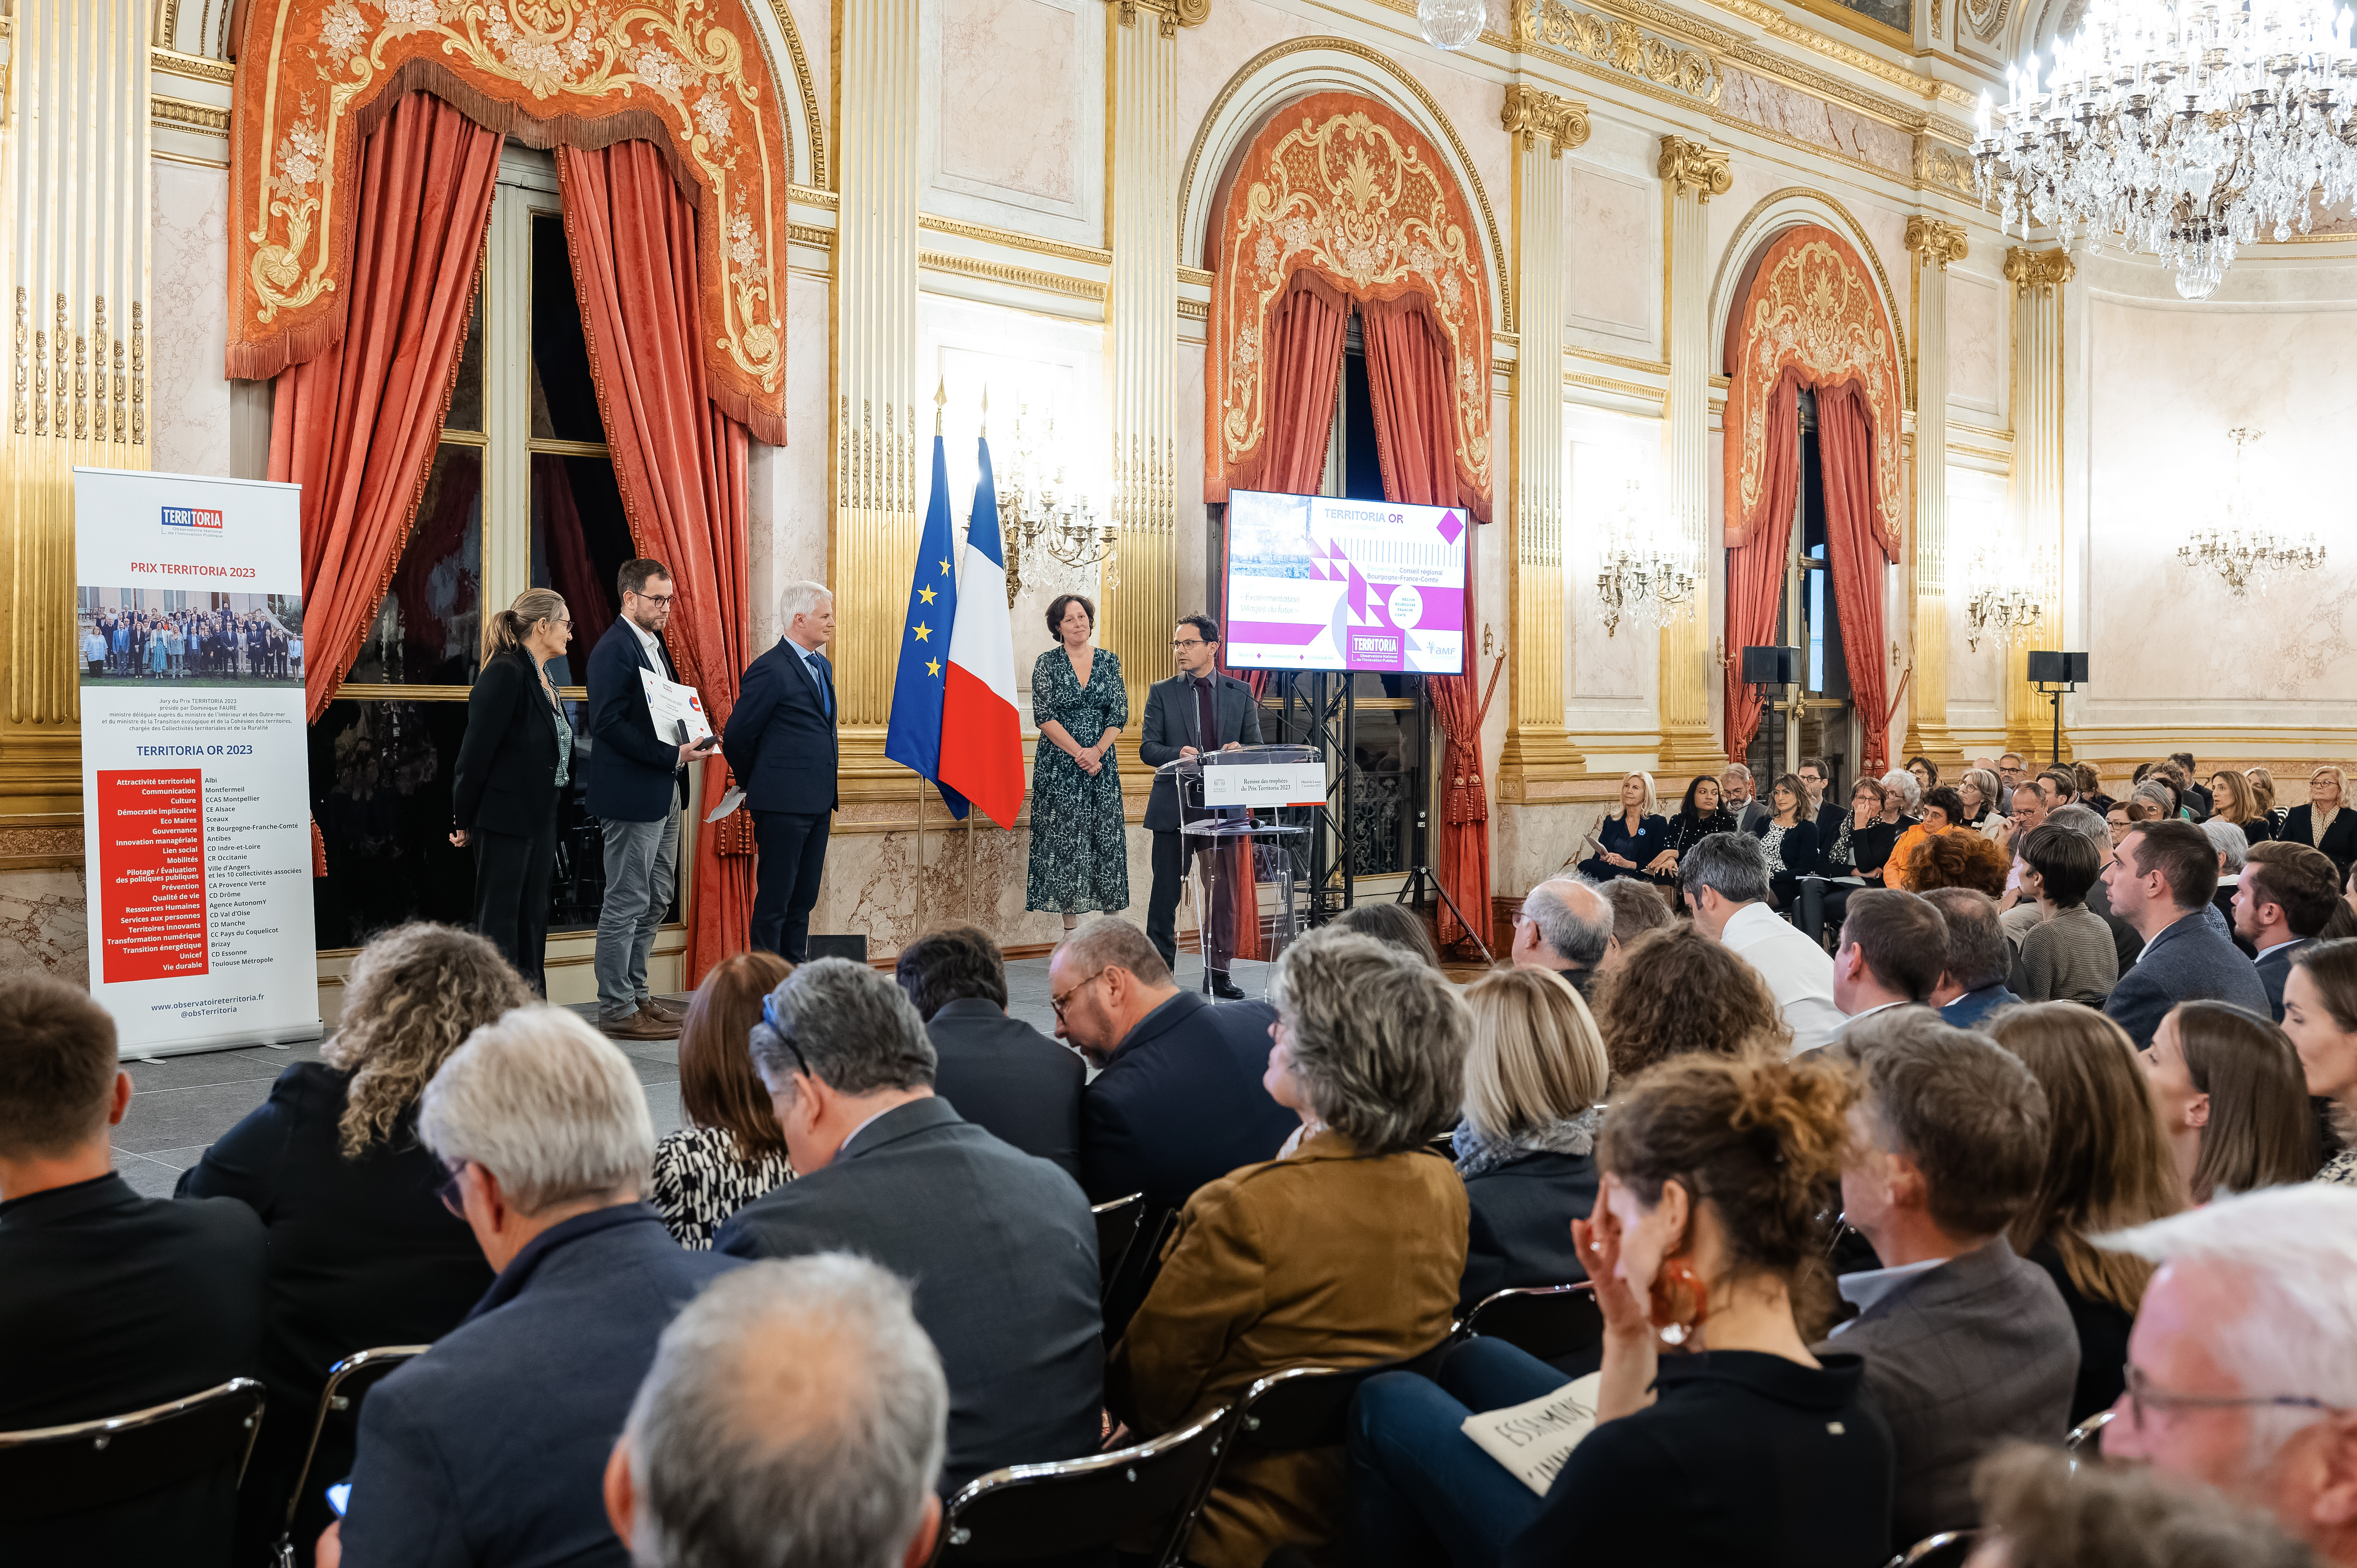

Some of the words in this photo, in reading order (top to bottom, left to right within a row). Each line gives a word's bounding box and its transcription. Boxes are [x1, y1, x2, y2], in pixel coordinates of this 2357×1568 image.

[163, 509, 221, 526] TERRITORIA
[1325, 509, 1385, 523] TERRITORIA
[1388, 514, 1403, 524] OR
[131, 562, 157, 573] PRIX
[160, 564, 227, 576] TERRITORIA
[230, 567, 256, 577] 2023
[1367, 573, 1438, 583] Bourgogne-France-Comté
[1354, 637, 1397, 652] TERRITORIA
[136, 746, 204, 756] TERRITORIA
[207, 745, 224, 755] OR
[226, 745, 253, 754] 2023
[159, 807, 196, 816] implicative
[217, 823, 298, 832] Bourgogne-Franche-Comté
[155, 837, 198, 845] managériale
[127, 869, 155, 877] Pilotage
[130, 876, 164, 884] politiques
[166, 874, 199, 882] publiques
[152, 893, 178, 902] Qualité
[165, 913, 201, 922] personnes
[128, 925, 165, 933] Territoires
[107, 935, 161, 945] Transformation
[163, 932, 201, 941] numérique
[123, 946, 158, 954] Transition
[160, 943, 201, 951] énergétique
[175, 961, 202, 969] durable
[151, 993, 264, 1011] www.observatoireterritoria.fr
[181, 1006, 237, 1018] @obsTerritoria
